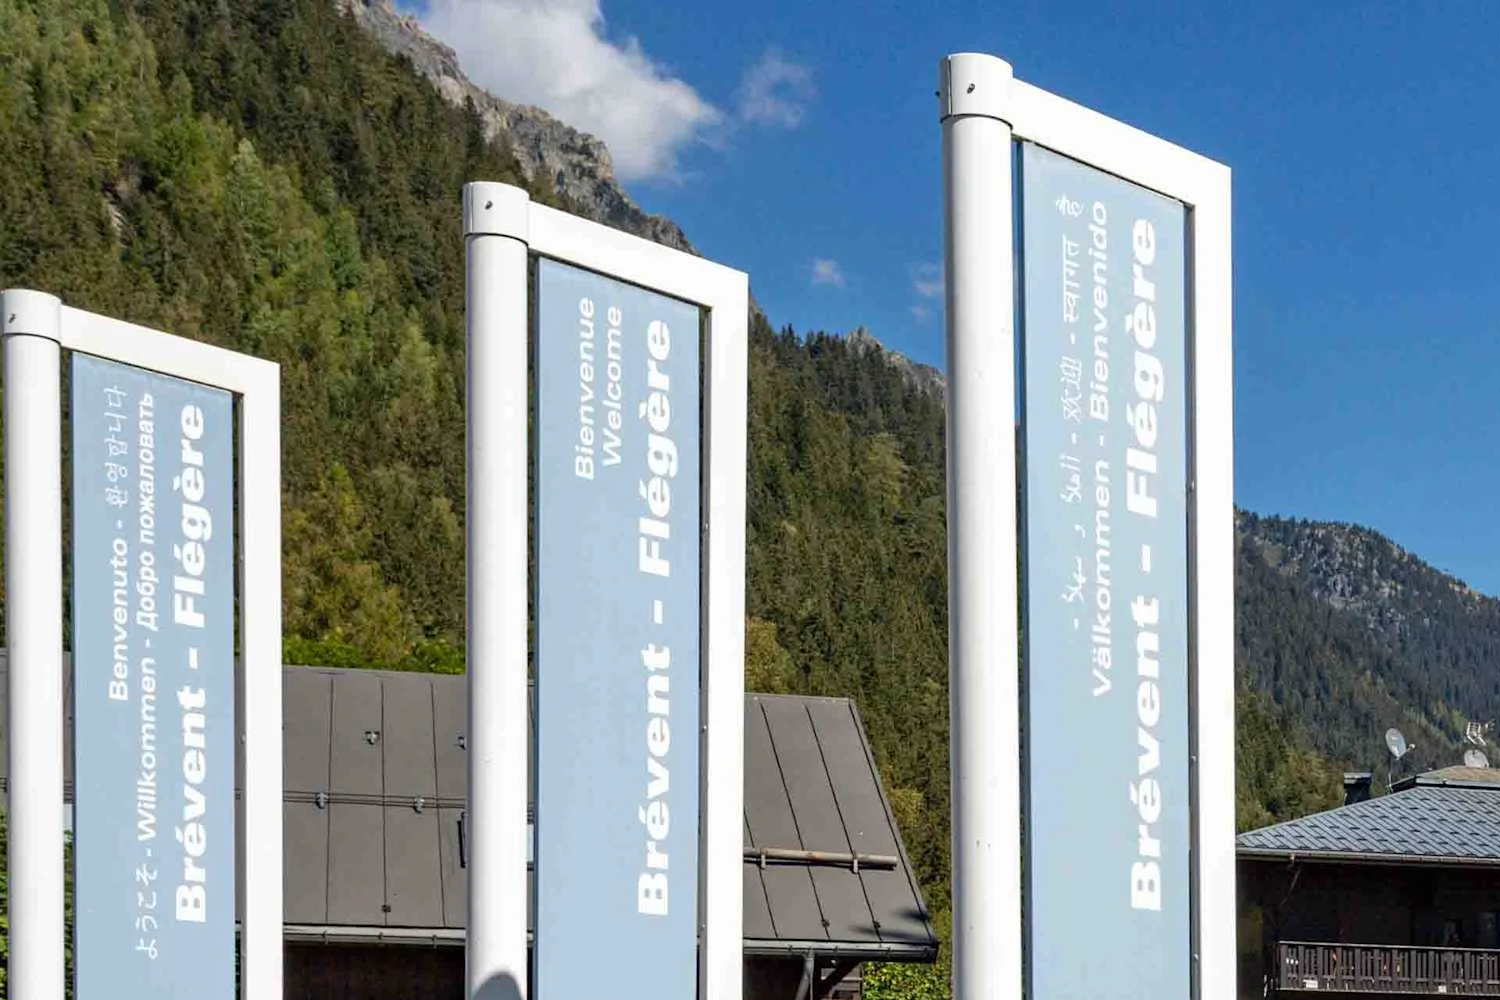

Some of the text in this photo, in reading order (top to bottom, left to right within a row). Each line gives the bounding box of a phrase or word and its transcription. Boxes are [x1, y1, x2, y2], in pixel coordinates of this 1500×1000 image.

[1062, 234, 1081, 324] स्वागत
[1087, 200, 1110, 423] Bienvenido
[1125, 218, 1165, 518] Flégère
[103, 384, 129, 508] 환영합니다
[139, 393, 155, 544] пожаловать
[575, 297, 595, 481] Bienvenue
[602, 306, 622, 467] Welcome
[638, 320, 678, 577] Flégère
[1060, 355, 1083, 423] 欢迎
[136, 551, 158, 632] Добро
[173, 404, 212, 628] Flégère
[1090, 459, 1112, 697] Välkommen
[108, 538, 128, 701] Benvenuto
[137, 657, 157, 842] Willkommen
[175, 685, 207, 923] Brévent
[638, 643, 671, 916] Brévent
[1129, 594, 1162, 913] Brévent
[135, 863, 158, 960] ようこそ
